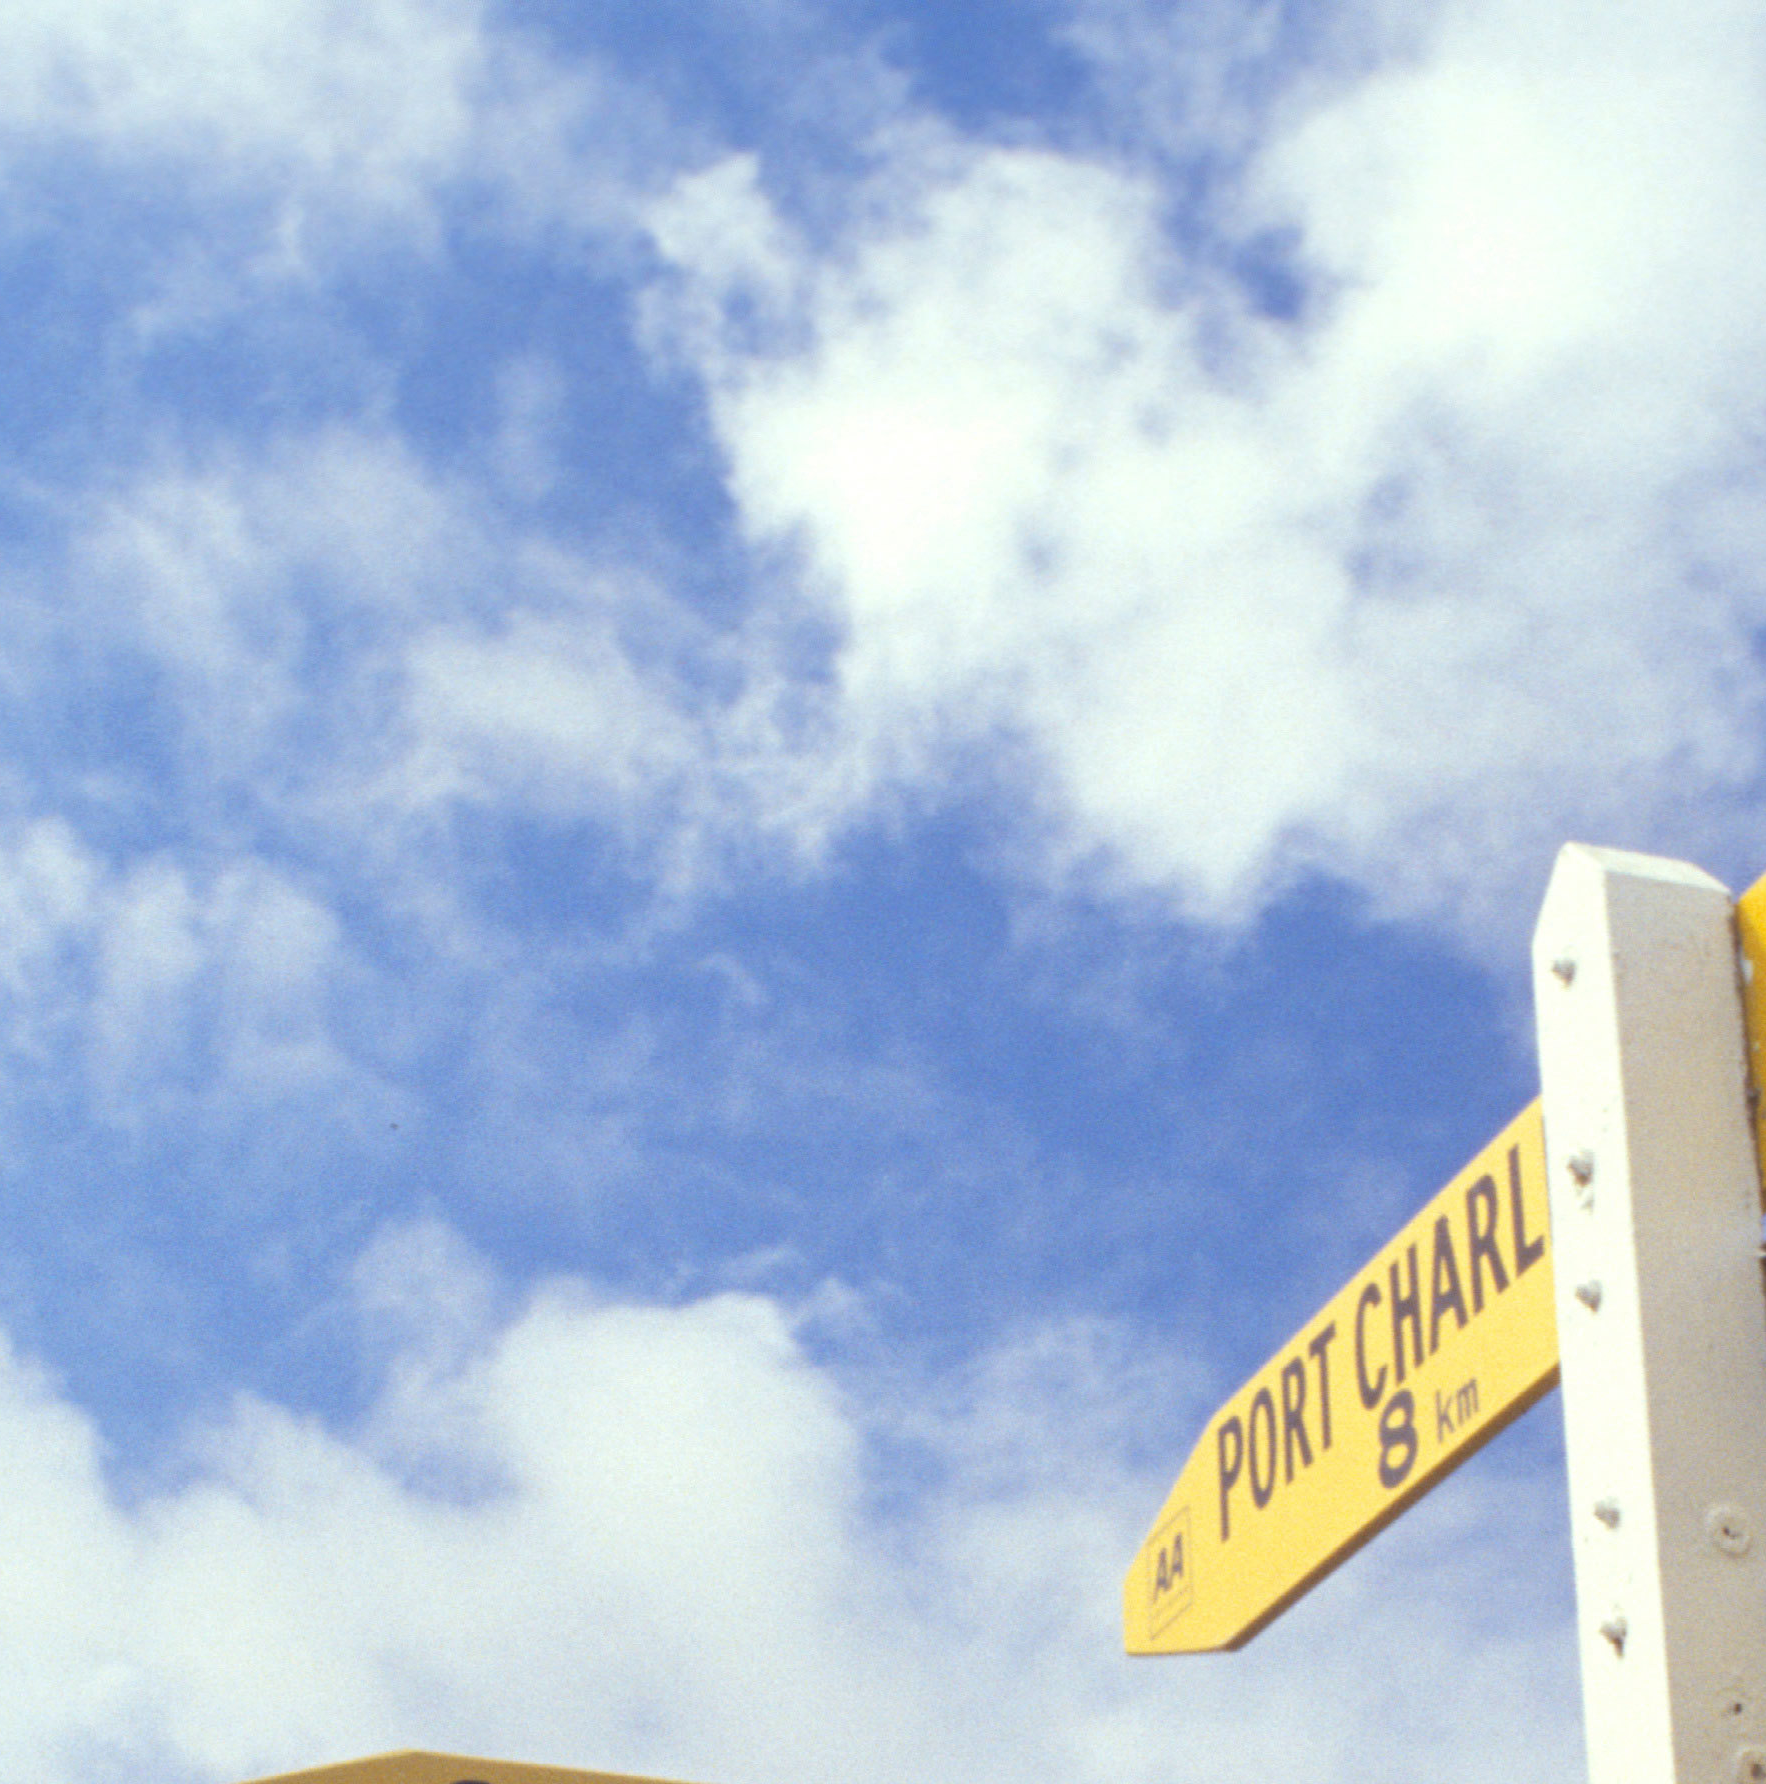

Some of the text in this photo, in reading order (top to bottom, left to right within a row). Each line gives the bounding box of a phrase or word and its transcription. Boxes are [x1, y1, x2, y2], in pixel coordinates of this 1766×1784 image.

[1216, 1143, 1545, 1543] PORT CHARL
[1378, 1377, 1478, 1489] 8 km
[1153, 1532, 1183, 1603] AA
